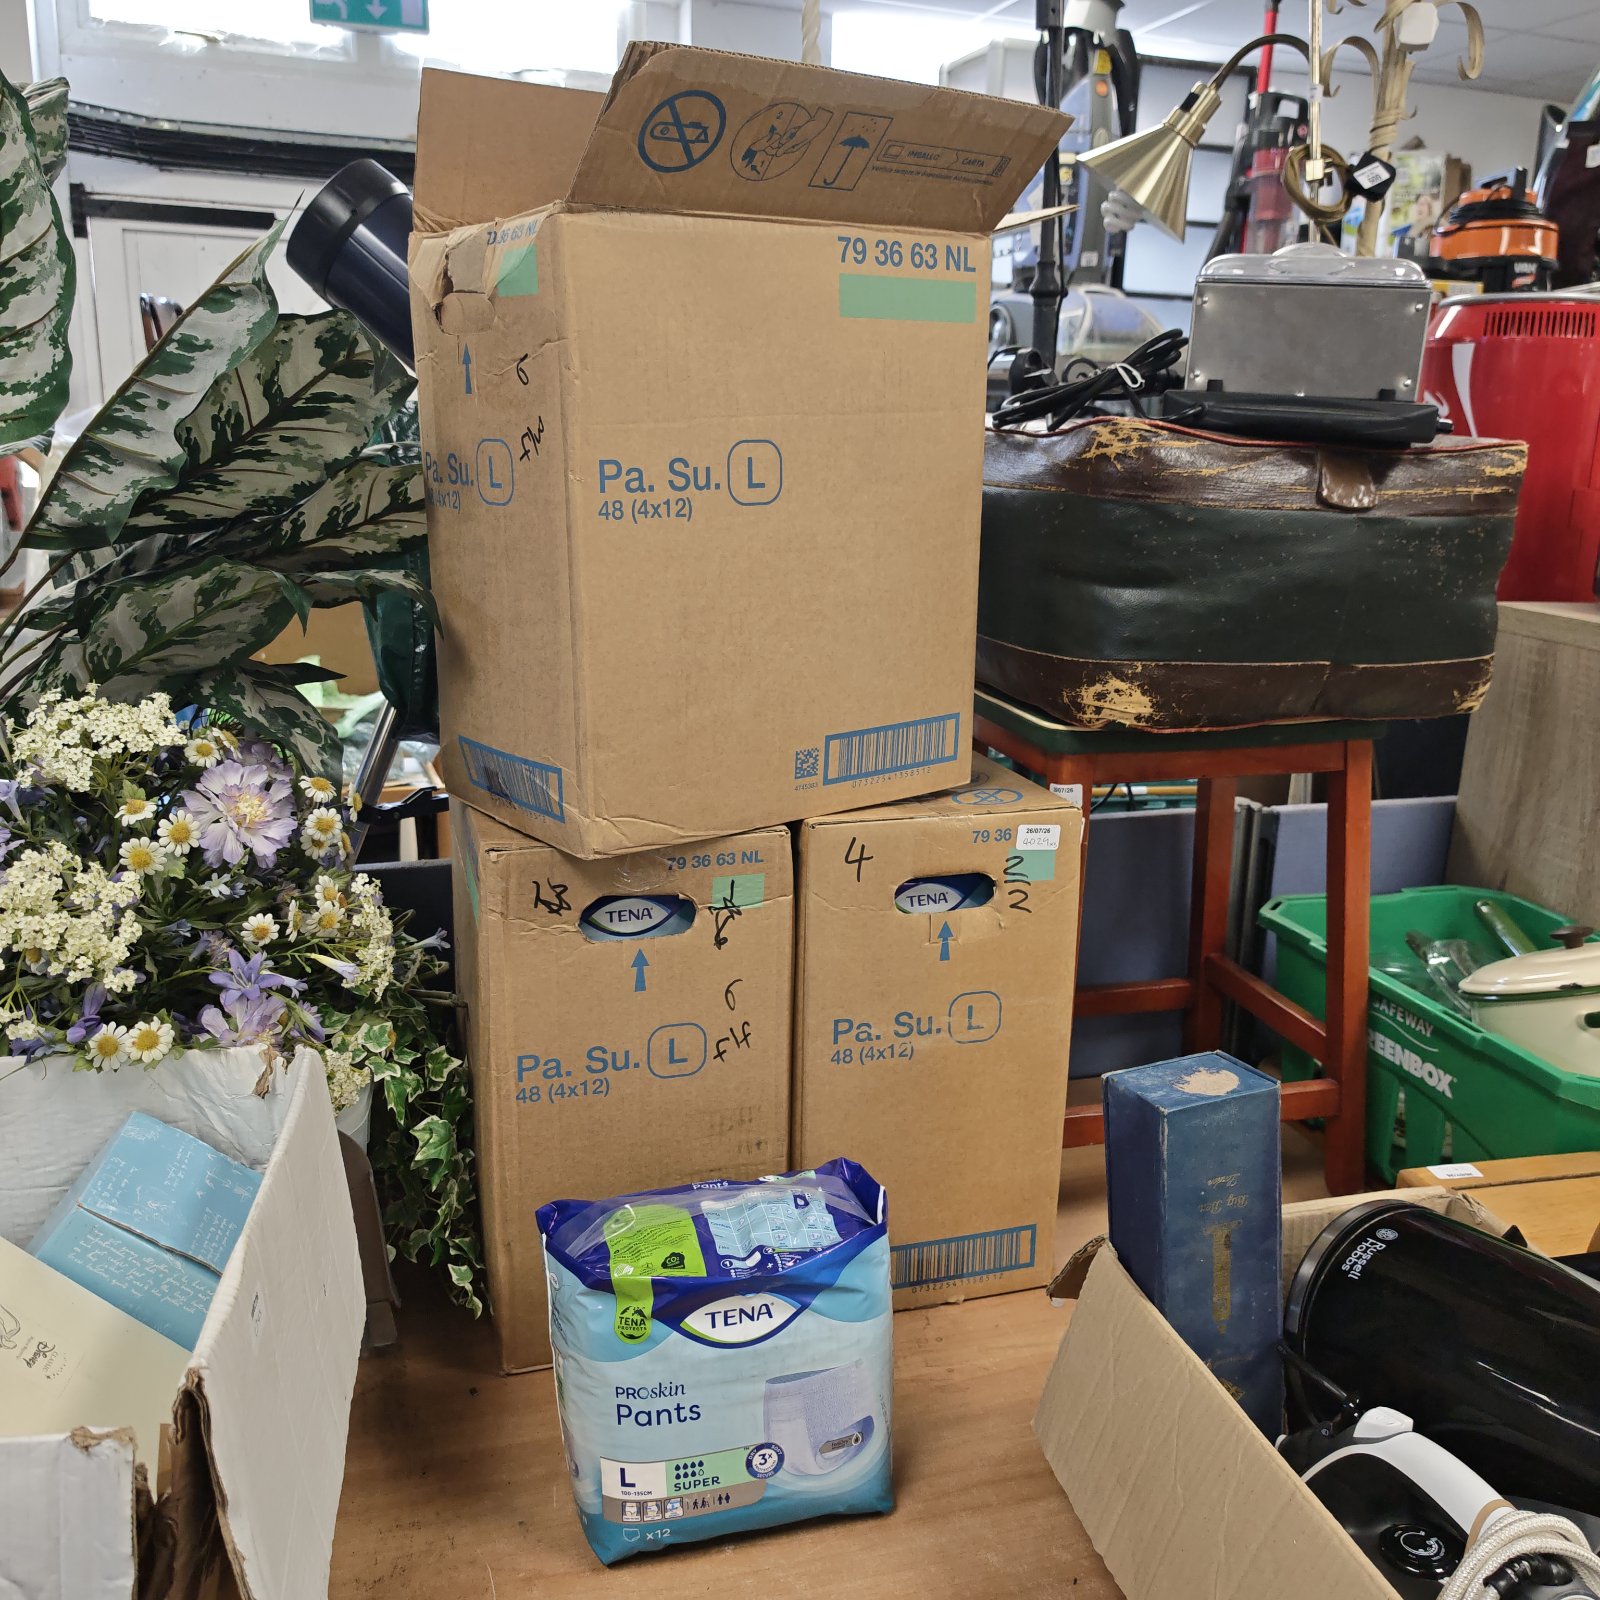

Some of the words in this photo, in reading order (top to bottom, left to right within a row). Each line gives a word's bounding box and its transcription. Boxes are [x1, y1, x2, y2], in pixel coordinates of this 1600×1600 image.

[837, 235, 867, 265] 79
[875, 239, 903, 268] 36
[911, 242, 938, 270] 63
[945, 244, 976, 273] NL
[425, 451, 443, 483] Pa.
[447, 452, 474, 487] Su.
[488, 455, 502, 489] L
[598, 459, 655, 494] Pa.
[668, 457, 721, 492] Su.
[747, 456, 766, 489] L
[598, 500, 625, 520] 48
[631, 496, 693, 525] (4x12)
[972, 829, 990, 844] 79
[994, 828, 1012, 842] 36
[666, 856, 687, 870] 79
[691, 854, 712, 869] 36
[716, 852, 736, 867] 63
[741, 850, 764, 864] NL
[844, 836, 874, 883] 4
[906, 891, 949, 908] TENA
[605, 906, 654, 923] TENA
[832, 1017, 881, 1045] Pa.
[893, 1011, 942, 1038] Su.
[966, 1004, 984, 1031] L
[1371, 999, 1434, 1037] SAFEWAY
[516, 1054, 572, 1083] Pa.
[585, 1045, 640, 1074] Su.
[668, 1038, 688, 1065] L
[830, 1049, 853, 1065] 48
[859, 1043, 915, 1065] (4x12)
[515, 1086, 541, 1104] 48
[548, 1077, 610, 1104] (4x12)
[1341, 1237, 1378, 1271] Hobbs
[1347, 1241, 1387, 1280] Russell
[618, 1316, 647, 1327] TENA
[704, 1303, 774, 1329] TENA
[616, 1402, 702, 1427] Pants
[770, 1444, 783, 1456] SOFT
[619, 1467, 636, 1488] L
[673, 1475, 721, 1492] SUPER
